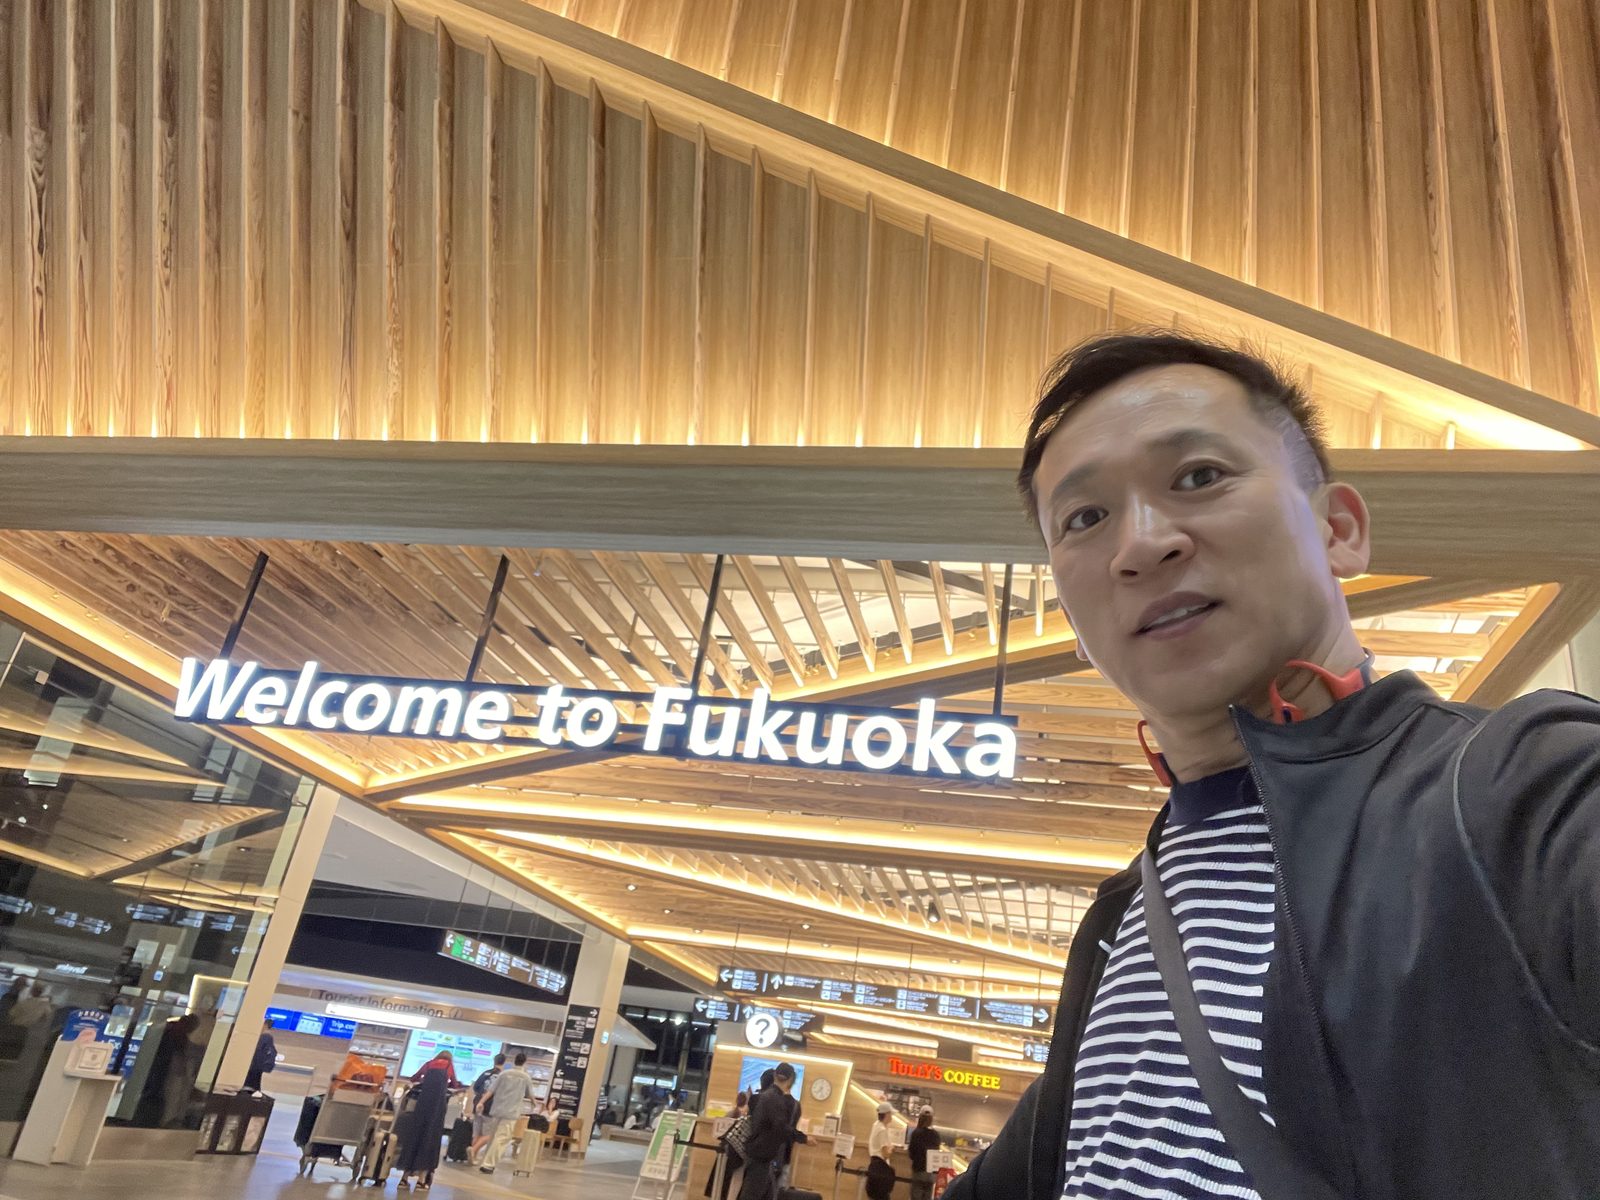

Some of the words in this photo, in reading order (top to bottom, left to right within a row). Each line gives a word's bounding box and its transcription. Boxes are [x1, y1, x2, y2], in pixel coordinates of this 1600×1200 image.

[174, 656, 509, 741] Welcome
[536, 683, 618, 748] to
[643, 686, 1017, 779] Fukuoka
[319, 989, 364, 1004] Tourist
[367, 997, 444, 1018] Information
[943, 1069, 1001, 1090] COFFEE
